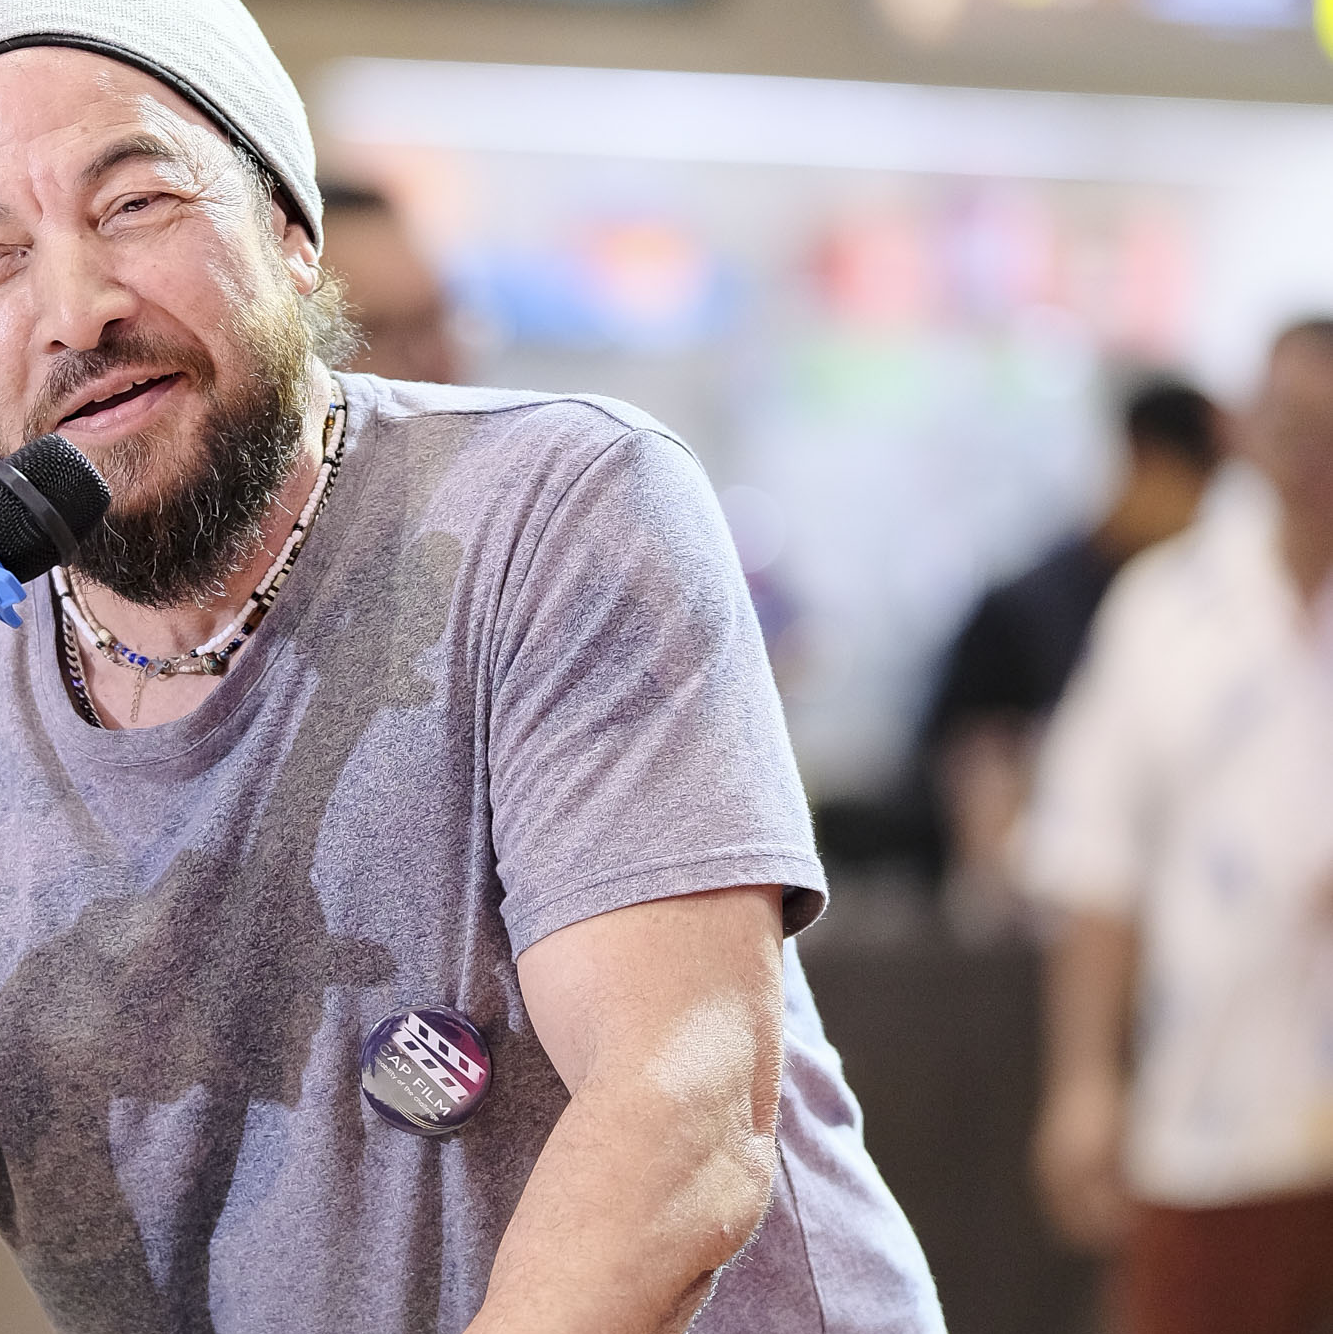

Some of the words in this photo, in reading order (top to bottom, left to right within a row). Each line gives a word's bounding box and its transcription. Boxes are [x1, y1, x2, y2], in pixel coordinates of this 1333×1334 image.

[379, 1044, 412, 1075] CAP
[412, 1077, 451, 1116] FILM
[403, 1085, 414, 1097] the
[413, 1096, 440, 1122] challenge
